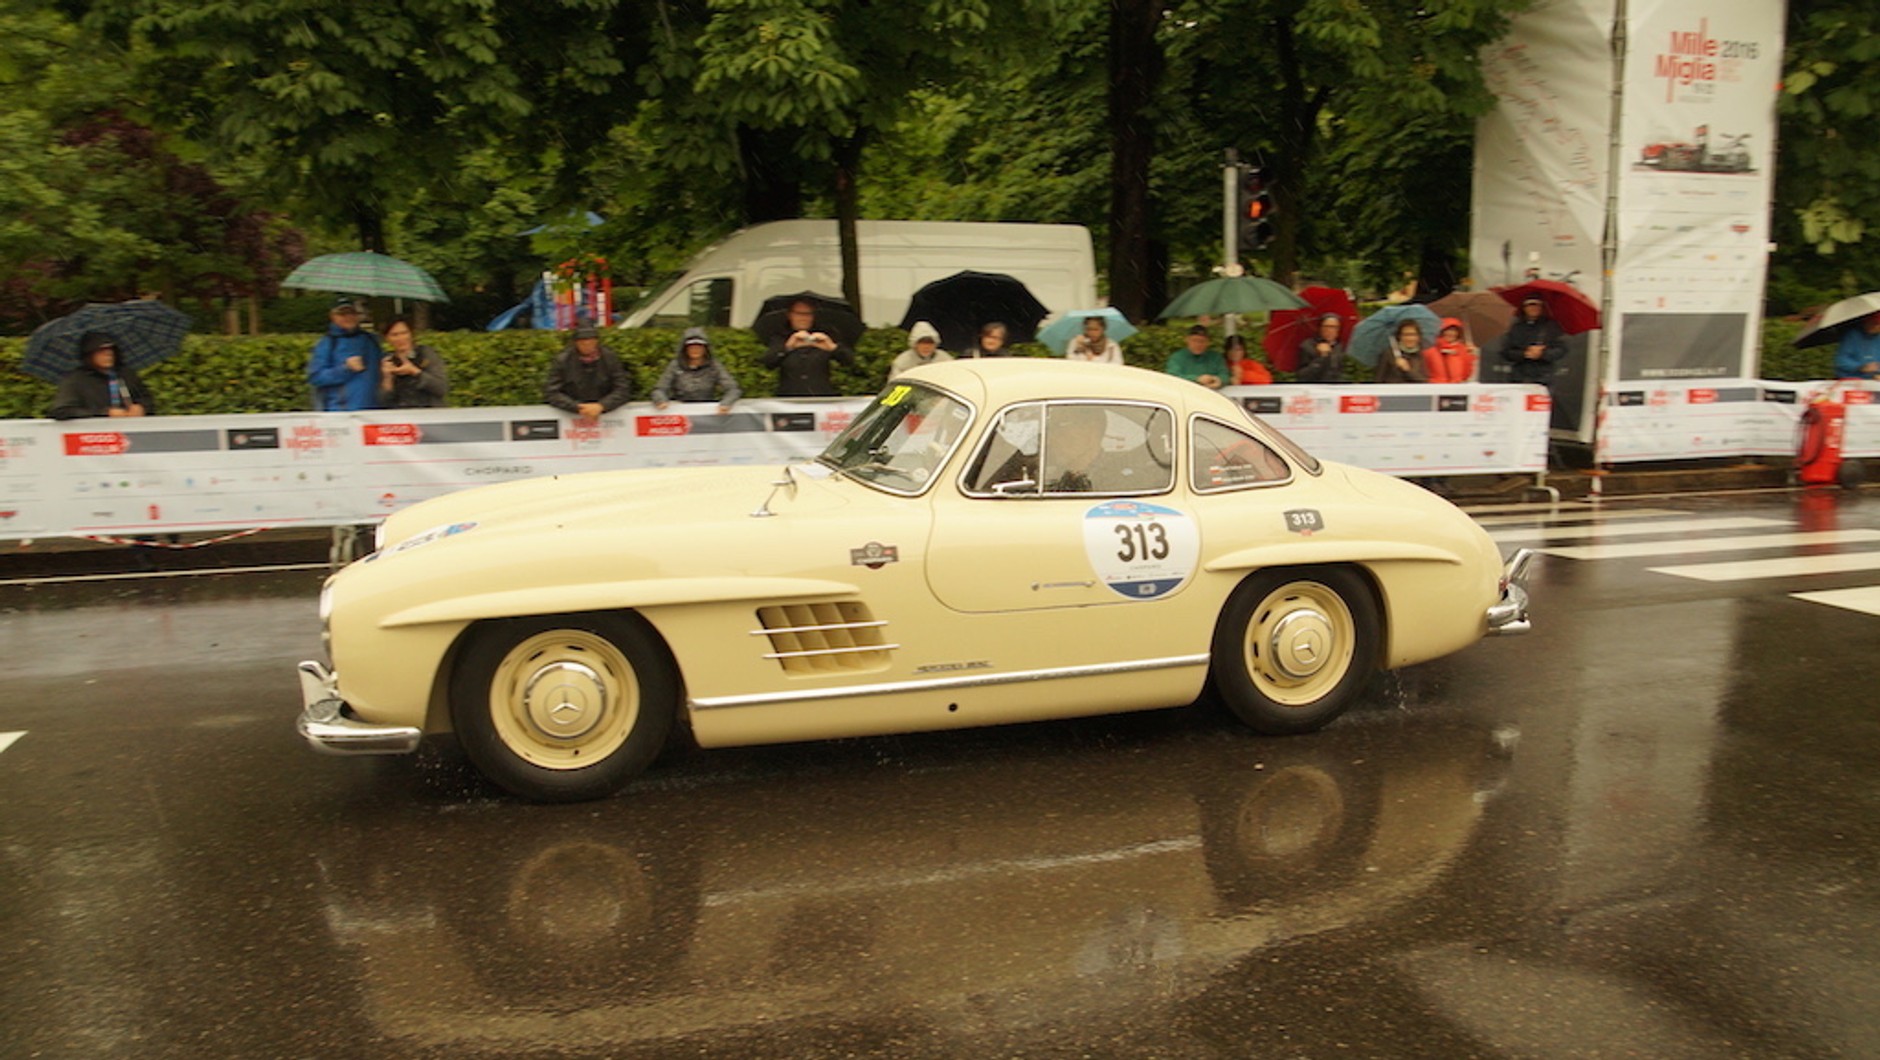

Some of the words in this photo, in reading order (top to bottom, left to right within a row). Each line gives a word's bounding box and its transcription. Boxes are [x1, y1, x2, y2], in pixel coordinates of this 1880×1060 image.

[1670, 18, 1717, 56] Mille
[1721, 40, 1758, 59] 2016
[1654, 55, 1715, 103] Miglia
[1292, 512, 1316, 525] 313
[1114, 522, 1169, 563] 313
